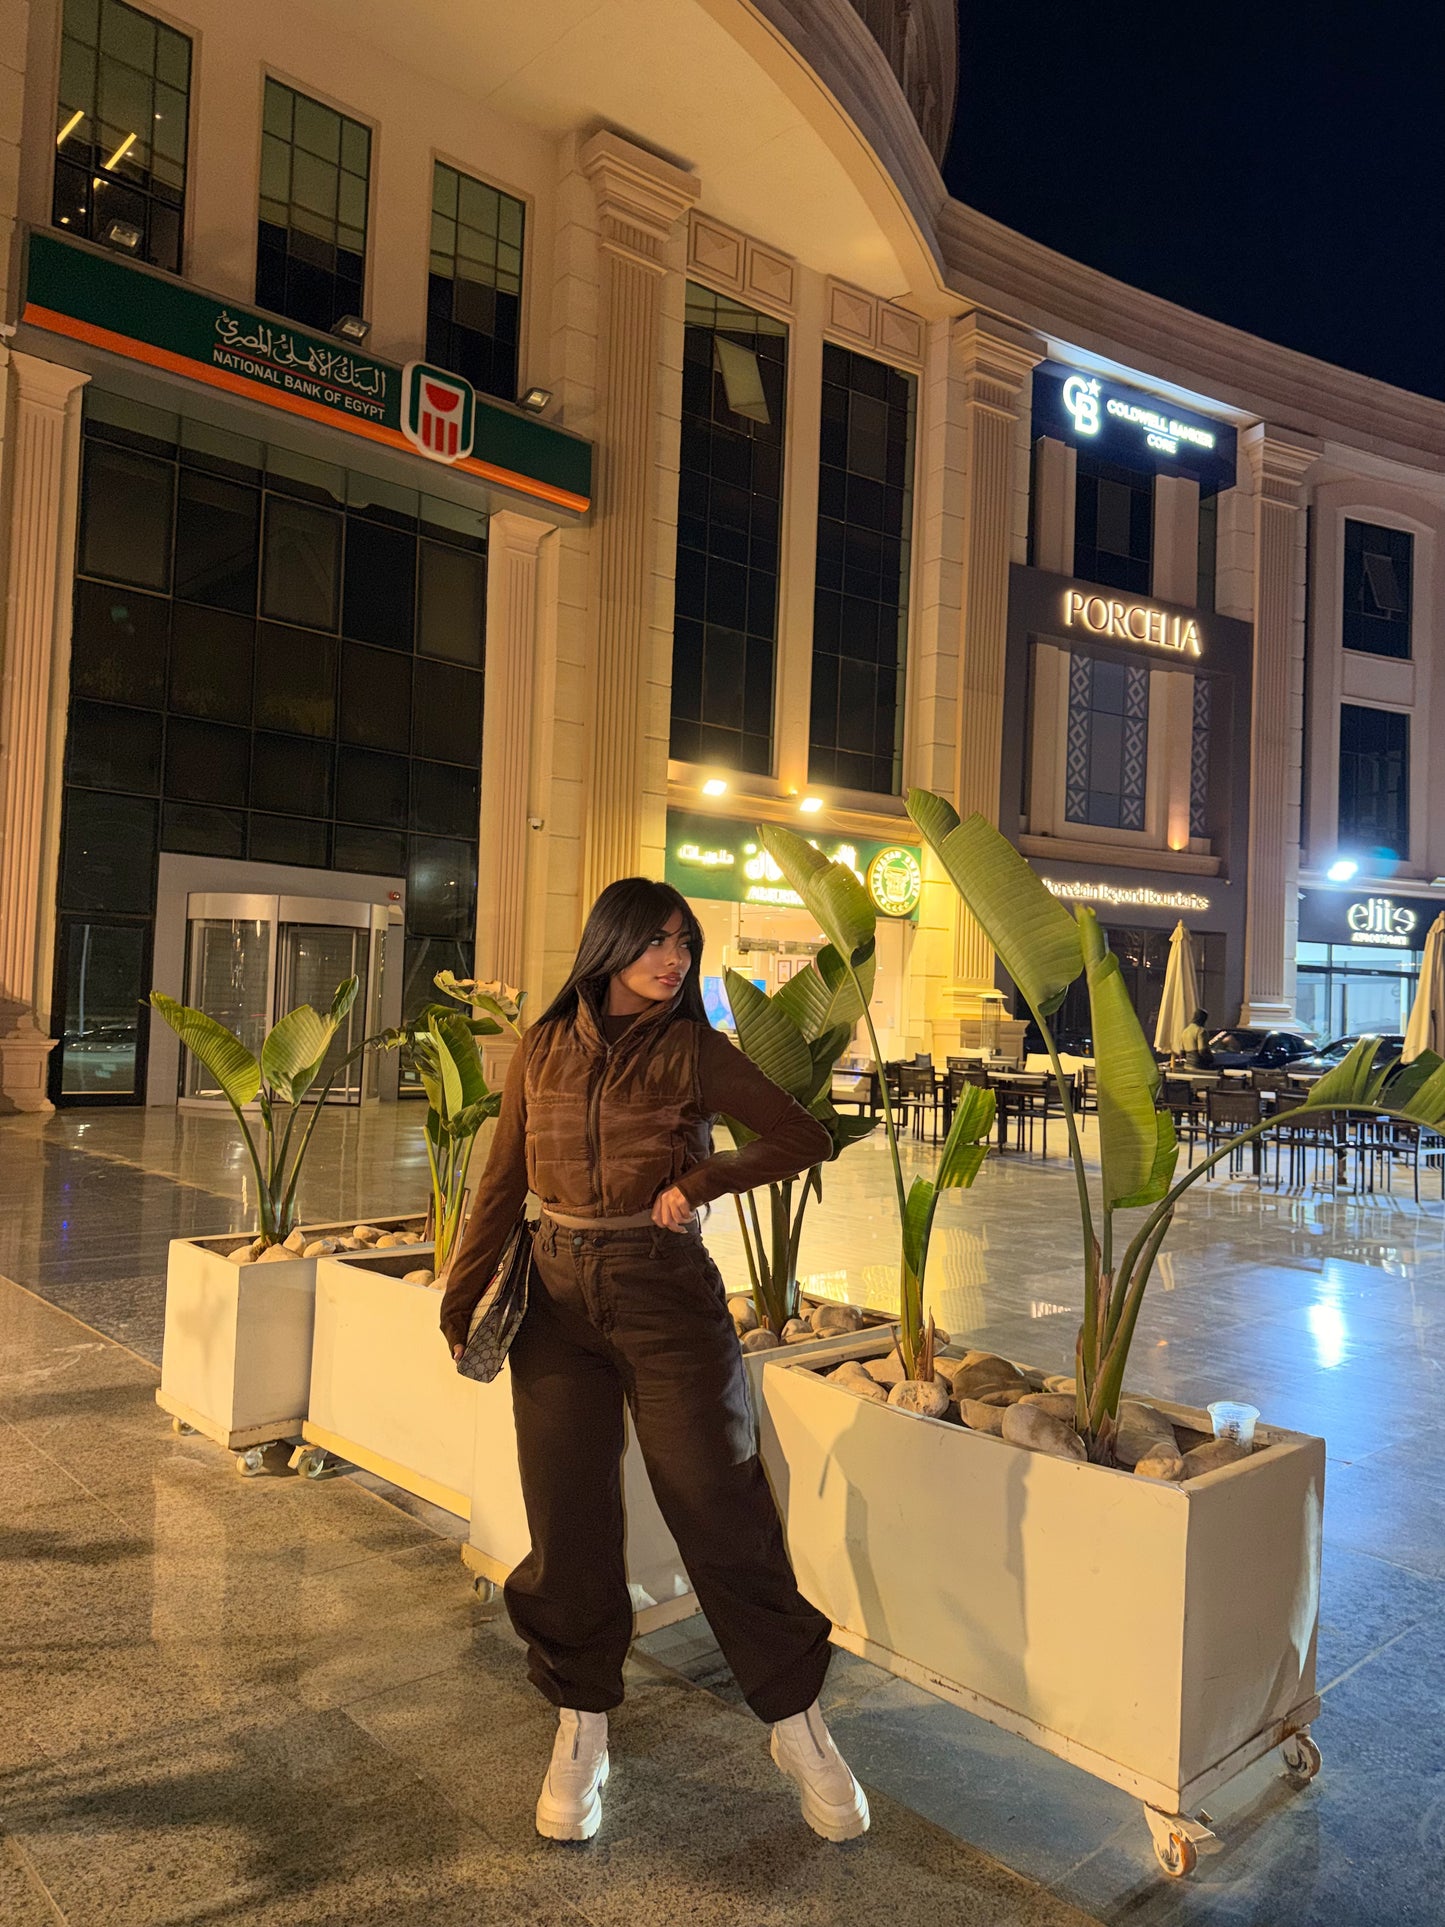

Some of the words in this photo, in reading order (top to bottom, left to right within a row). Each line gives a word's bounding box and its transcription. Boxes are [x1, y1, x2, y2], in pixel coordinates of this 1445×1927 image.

[213, 349, 282, 385] NATIONAL
[284, 374, 322, 399] BANK
[324, 389, 342, 405] OF
[344, 396, 385, 421] EGYPT
[1107, 400, 1168, 432] COLDWELL
[1170, 421, 1213, 449] BANKER
[1147, 434, 1177, 454] CORE
[1065, 589, 1201, 656] PORCELIA
[1348, 898, 1416, 934] elite
